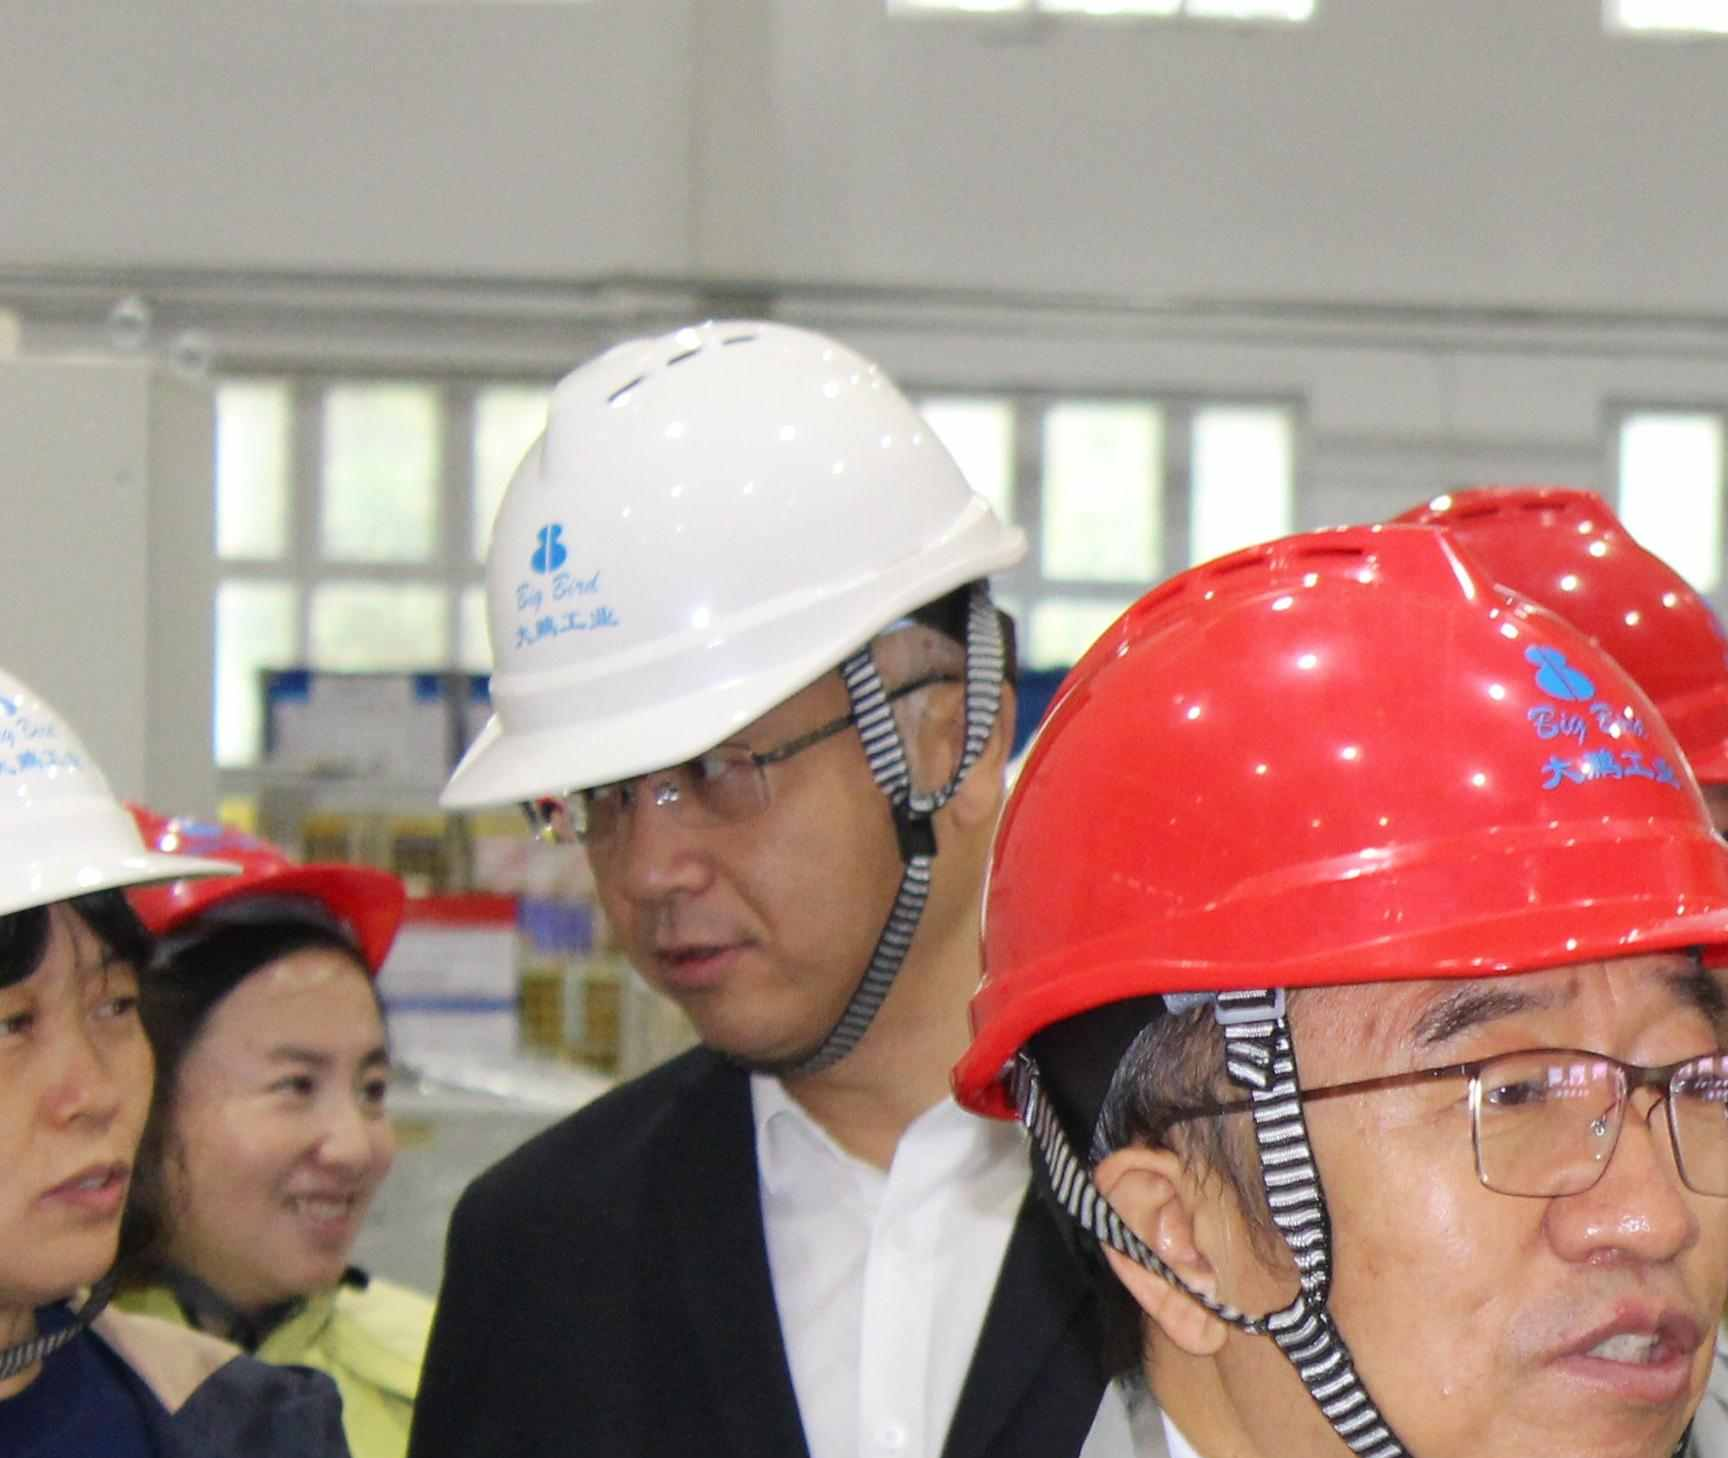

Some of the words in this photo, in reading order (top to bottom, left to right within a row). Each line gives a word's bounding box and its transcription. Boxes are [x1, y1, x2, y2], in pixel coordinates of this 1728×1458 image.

[515, 581, 543, 614] Big
[552, 570, 600, 600] Bird
[1527, 704, 1589, 744] Big
